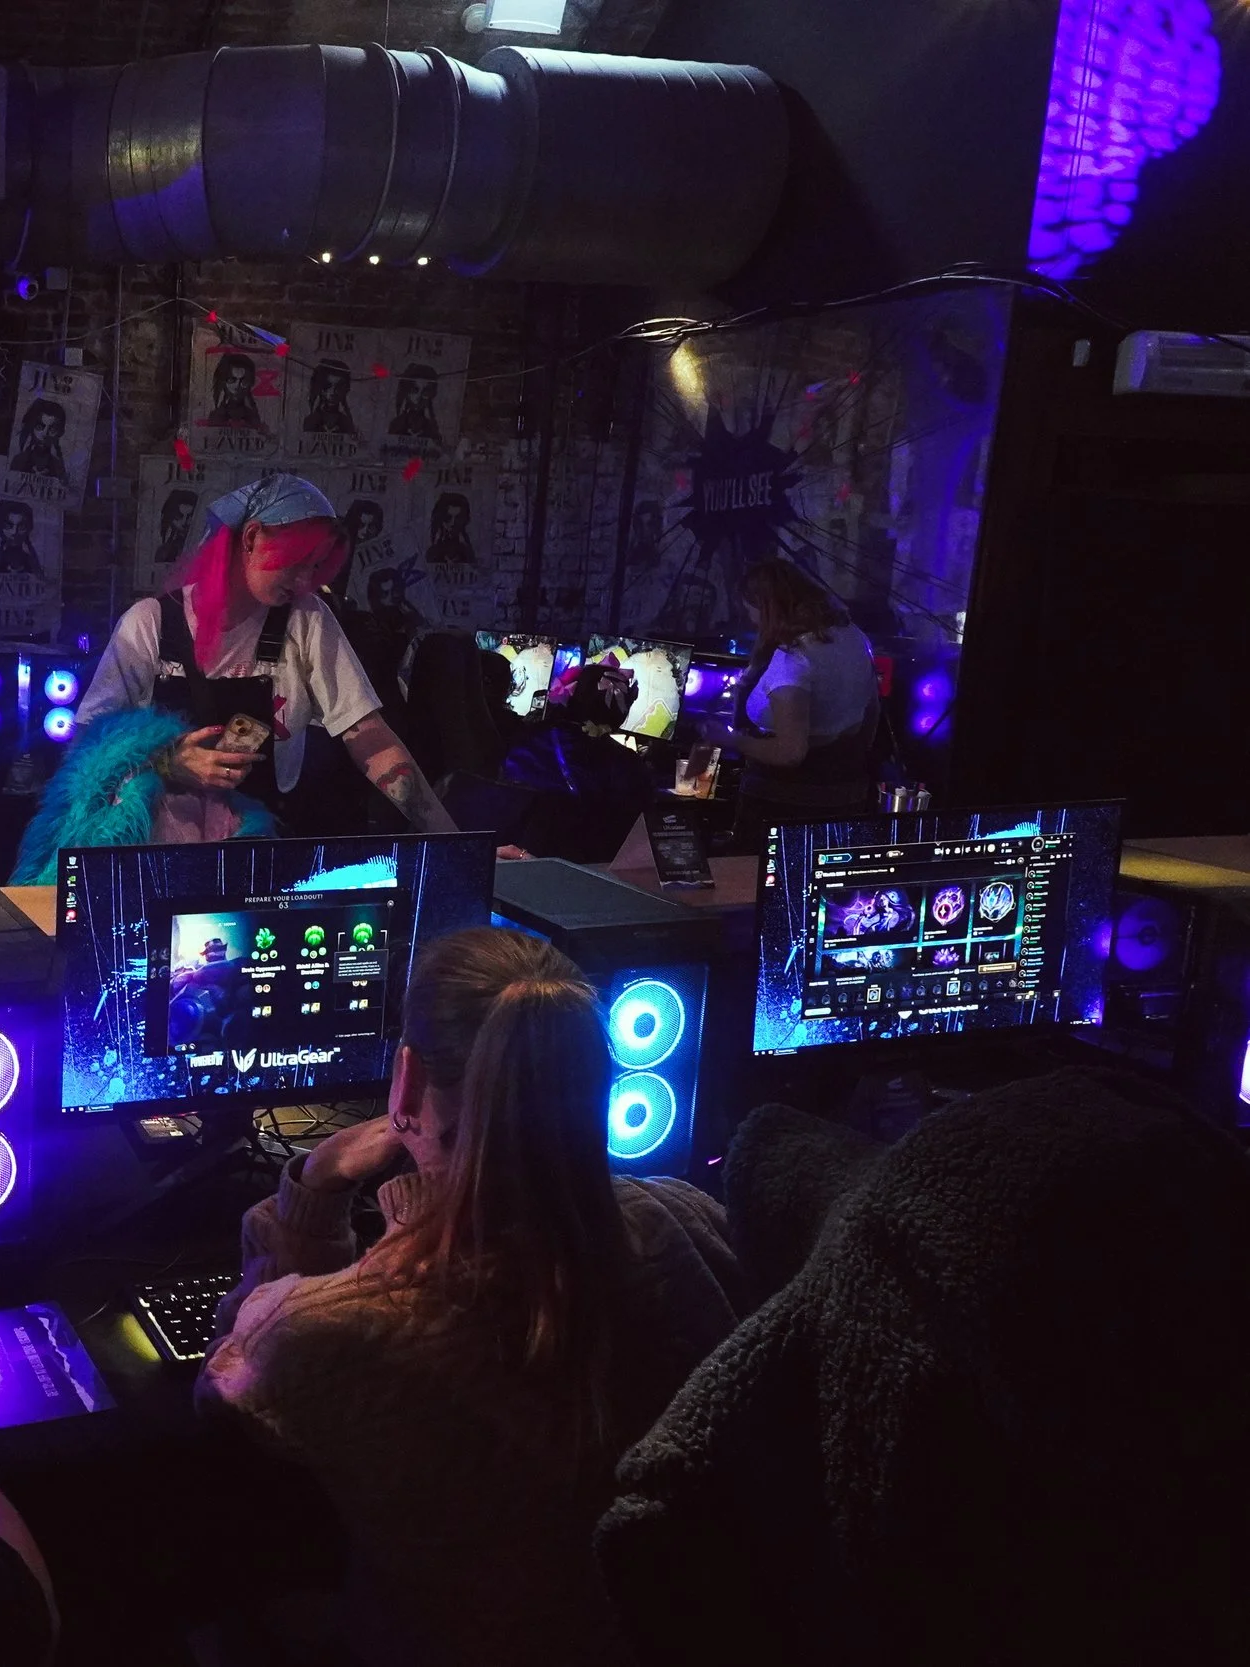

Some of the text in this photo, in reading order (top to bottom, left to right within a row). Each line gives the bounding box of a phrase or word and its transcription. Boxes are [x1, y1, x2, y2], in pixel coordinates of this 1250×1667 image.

[29, 370, 73, 394] JINX
[749, 470, 774, 508] SEE
[291, 893, 323, 901] LOADOUT!
[260, 1049, 335, 1068] UltraGear
